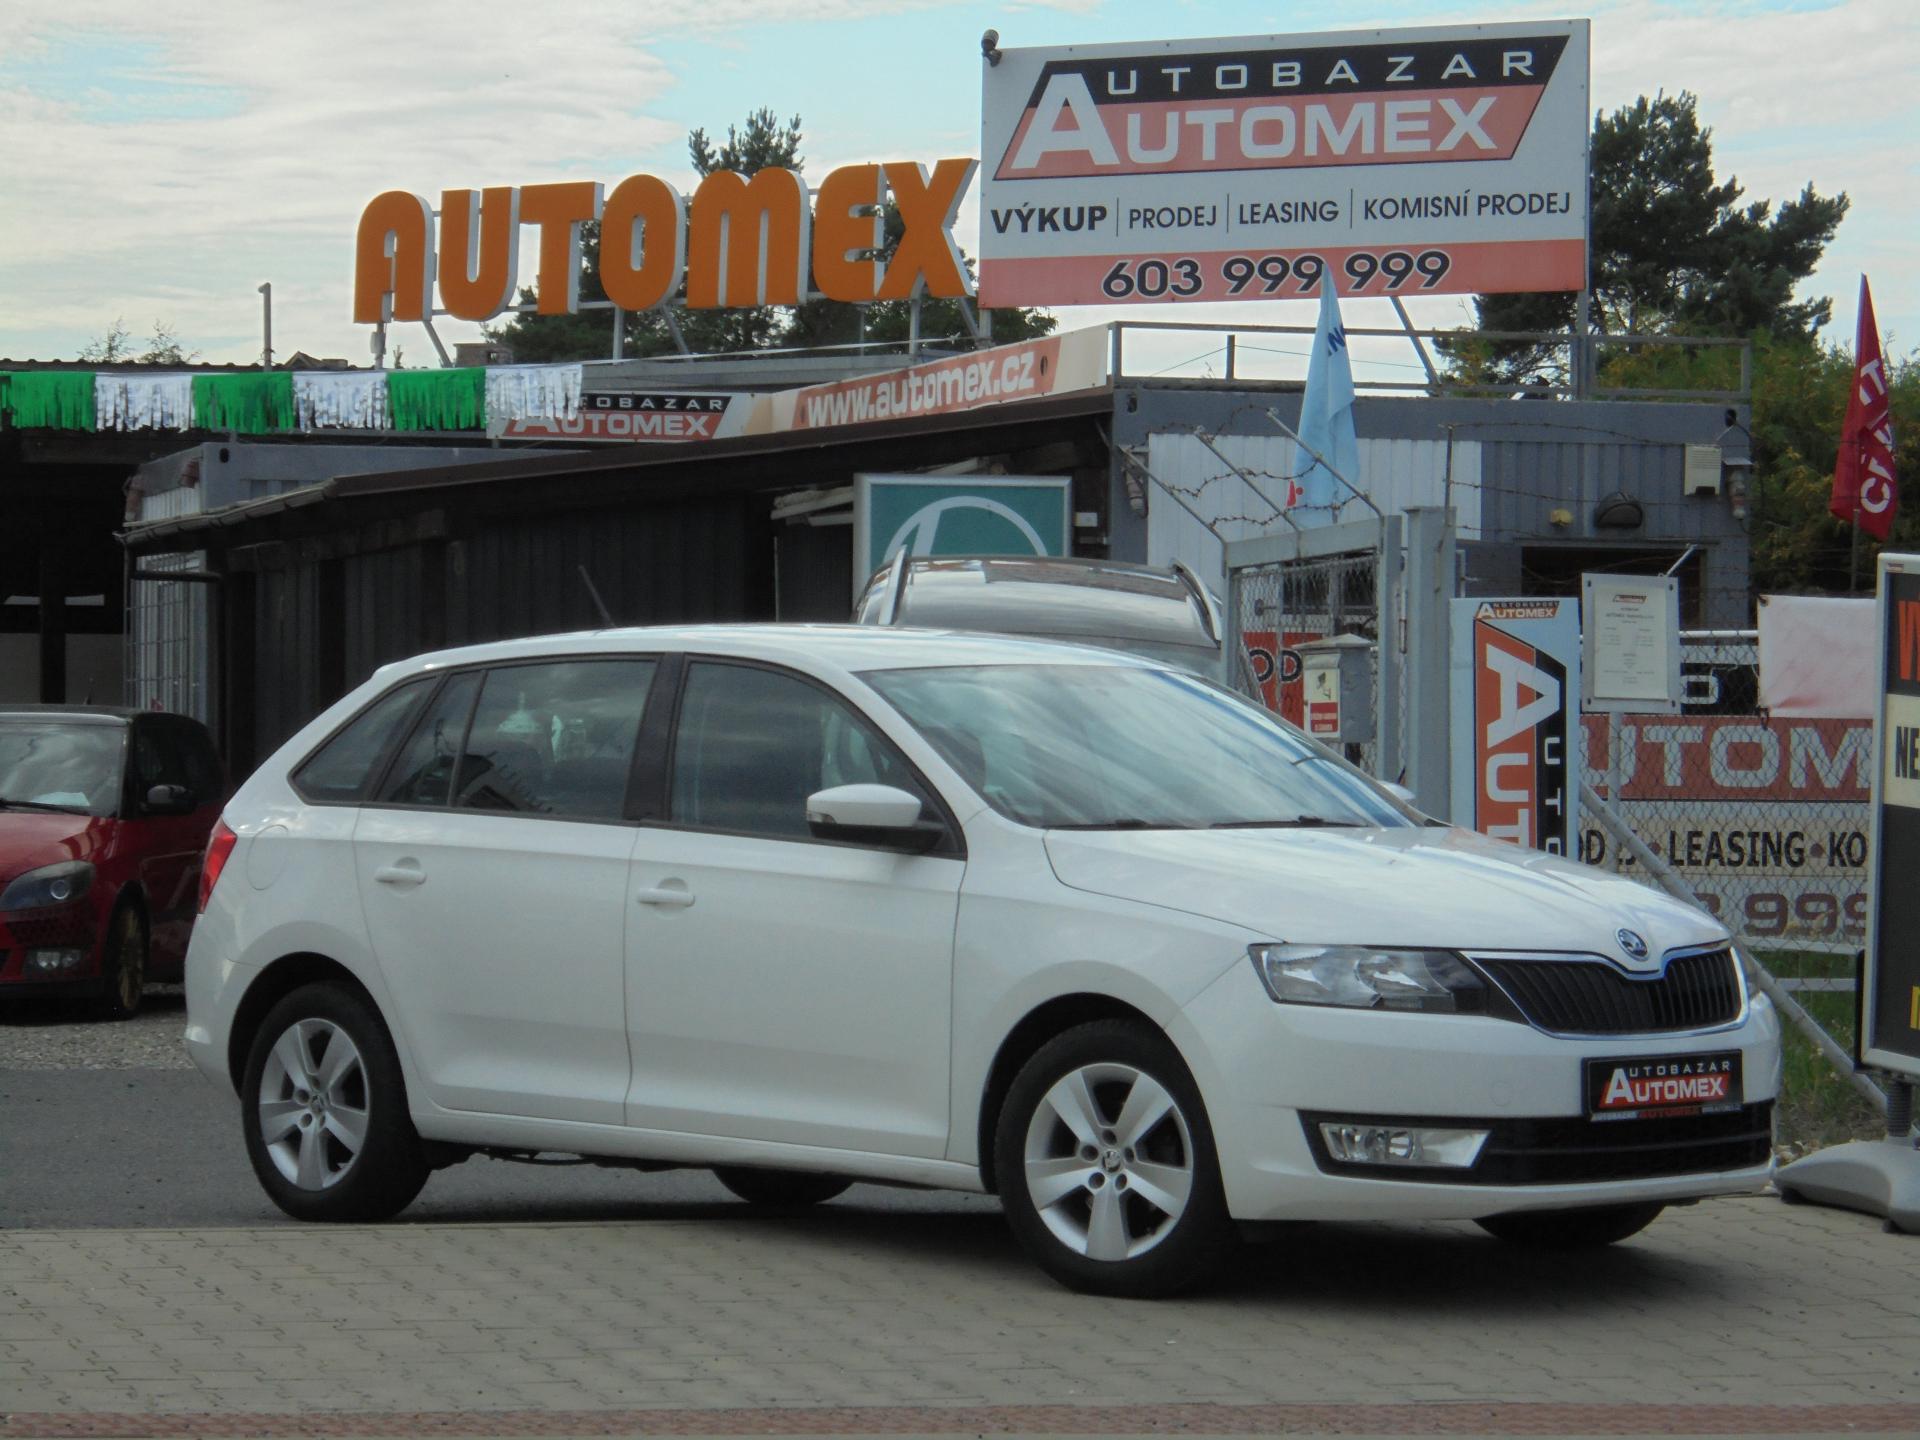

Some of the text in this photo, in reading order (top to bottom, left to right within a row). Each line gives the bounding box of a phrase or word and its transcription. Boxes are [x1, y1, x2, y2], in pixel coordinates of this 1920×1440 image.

[1010, 73, 1498, 170] AUTOMEX
[991, 189, 1571, 235] VÝKUP PRODEJ LEASING KOMISNÍ PRODEJ
[354, 158, 980, 324] AUTOMEX
[1101, 249, 1451, 299] 603 999 999
[576, 396, 724, 411] OBAZAR
[807, 351, 1036, 428] www.automex.cz
[1476, 602, 1554, 618] AUTOMEX
[1668, 830, 1804, 867] LEASING
[1605, 1068, 1724, 1104] AUTOMEX
